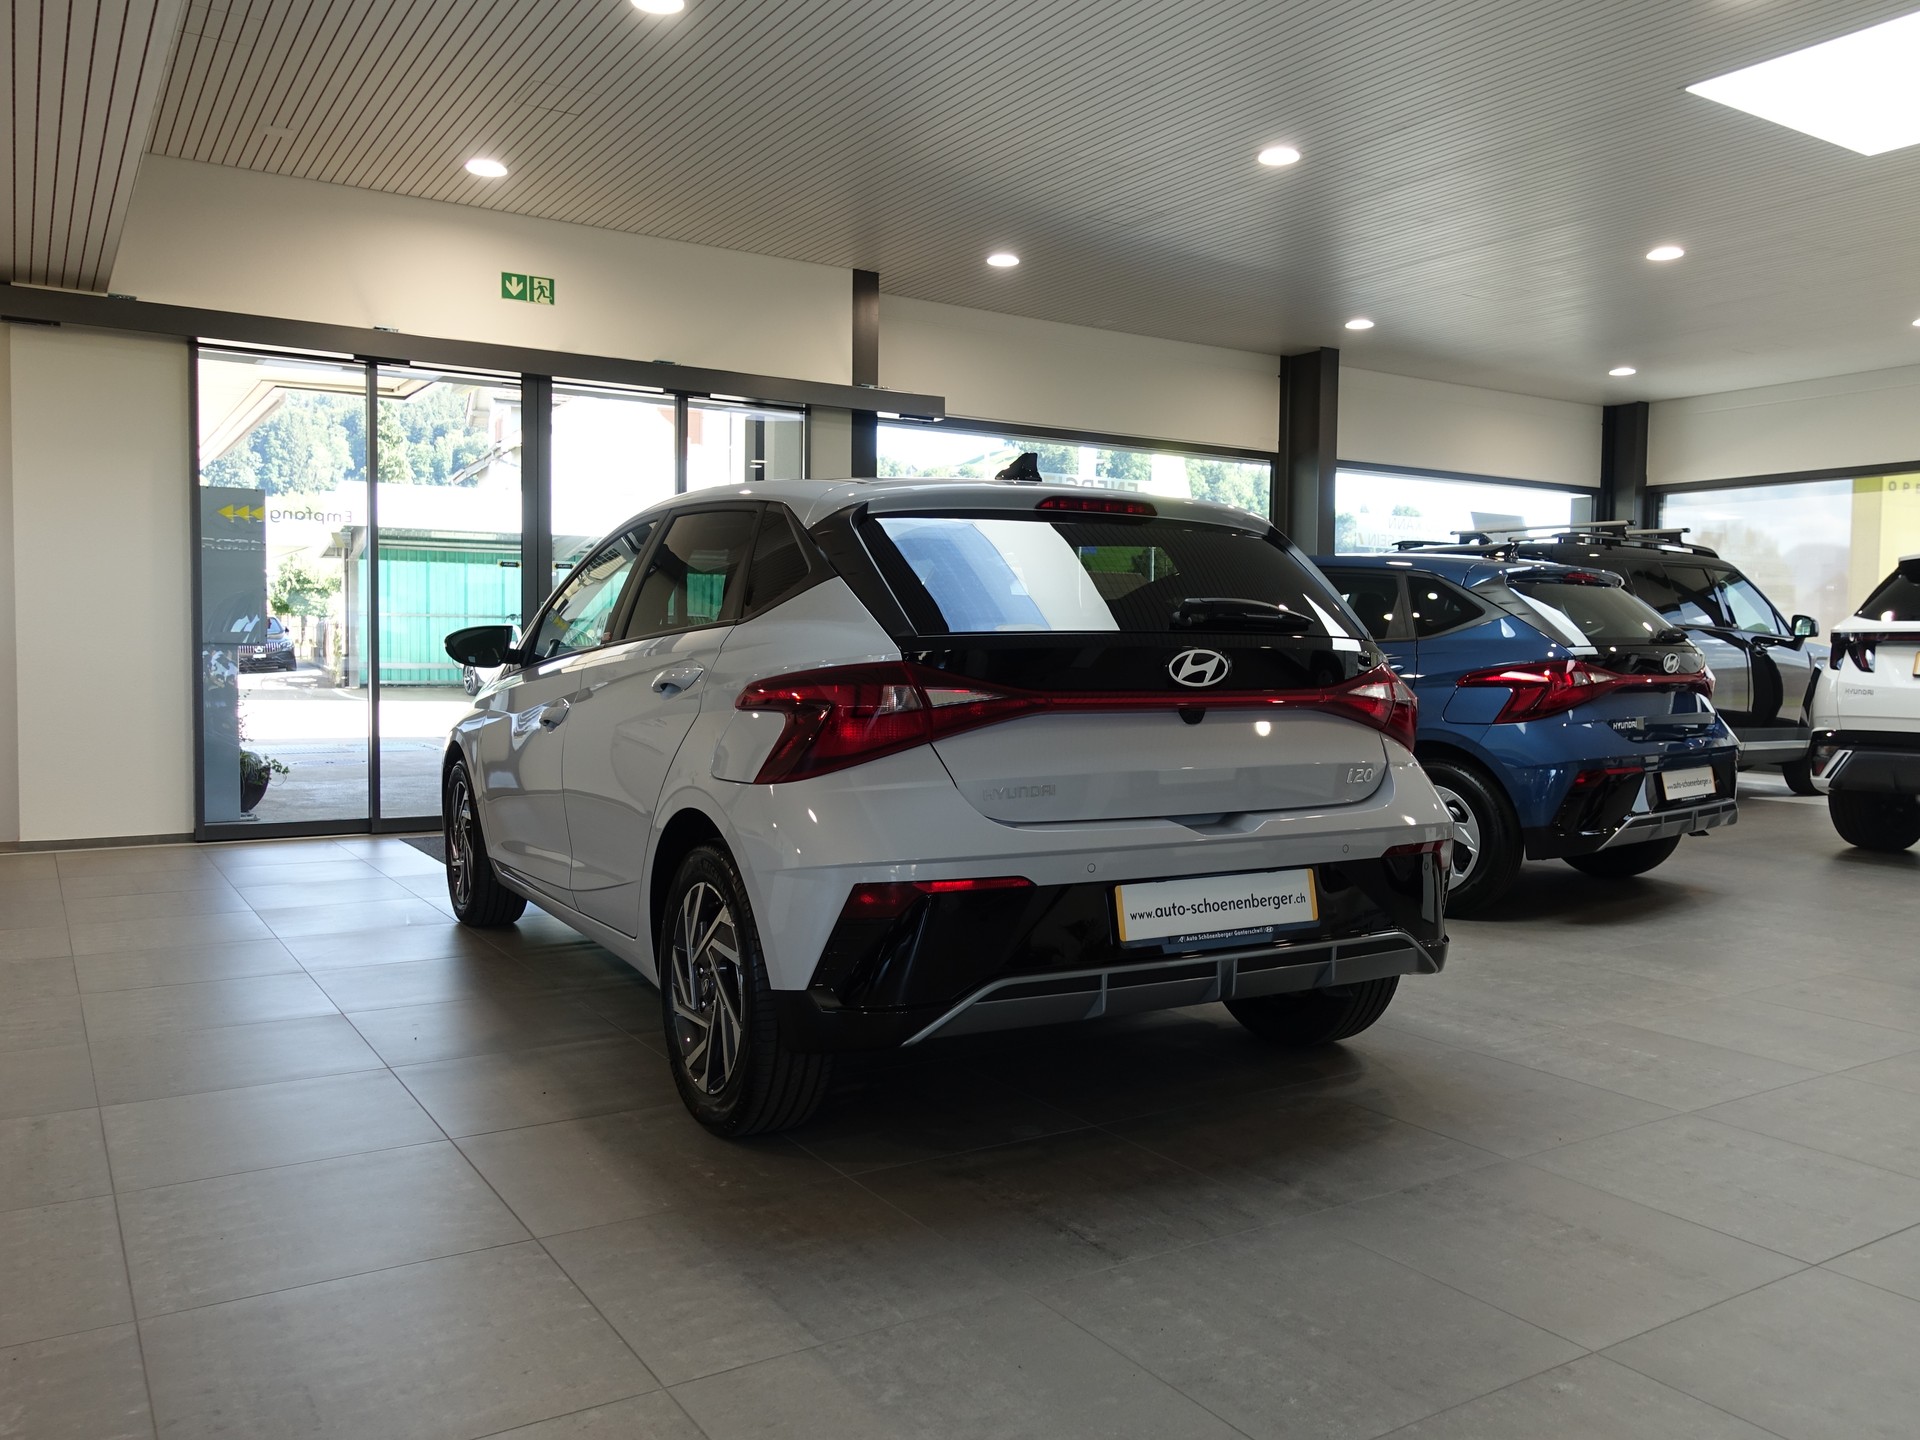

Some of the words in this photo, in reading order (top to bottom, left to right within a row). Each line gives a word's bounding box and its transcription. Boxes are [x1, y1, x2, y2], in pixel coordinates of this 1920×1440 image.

[1845, 688, 1875, 696] HYUNDAI
[1612, 720, 1637, 730] HYUNDAI
[983, 784, 1056, 801] HYUNDAI
[1129, 893, 1306, 920] www.auto-schoenenberger.ch
